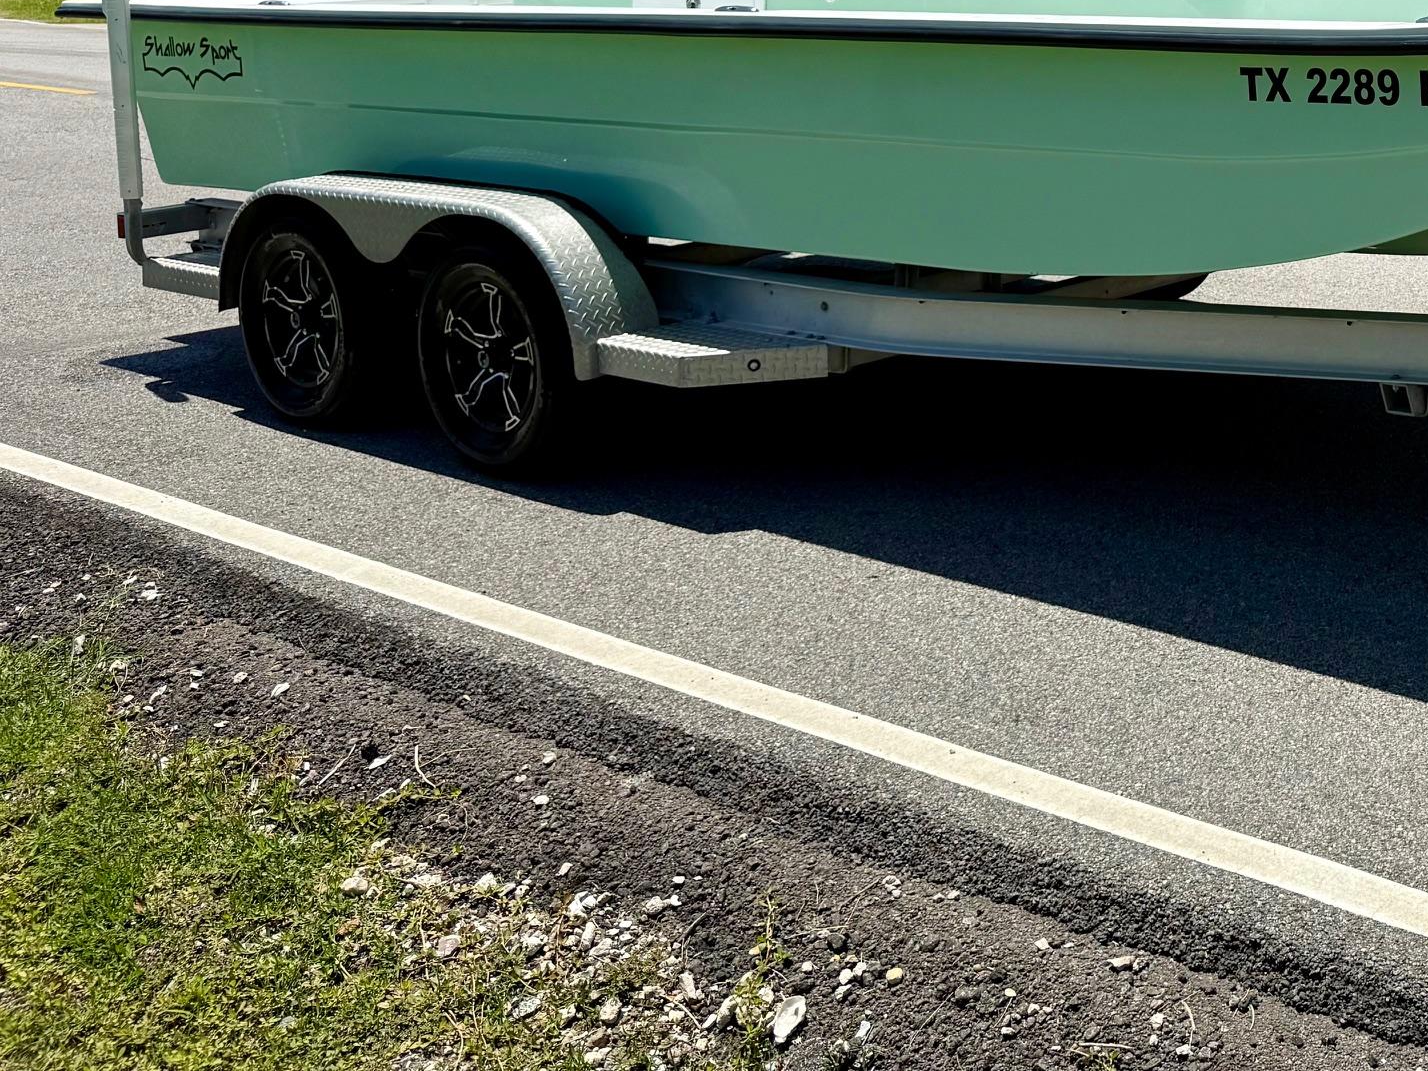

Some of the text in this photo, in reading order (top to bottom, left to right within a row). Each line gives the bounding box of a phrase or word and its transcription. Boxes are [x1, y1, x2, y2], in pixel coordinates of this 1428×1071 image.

[143, 35, 241, 66] Shallow Sport
[1240, 67, 1291, 102] TX
[1306, 68, 1400, 107] 2289
